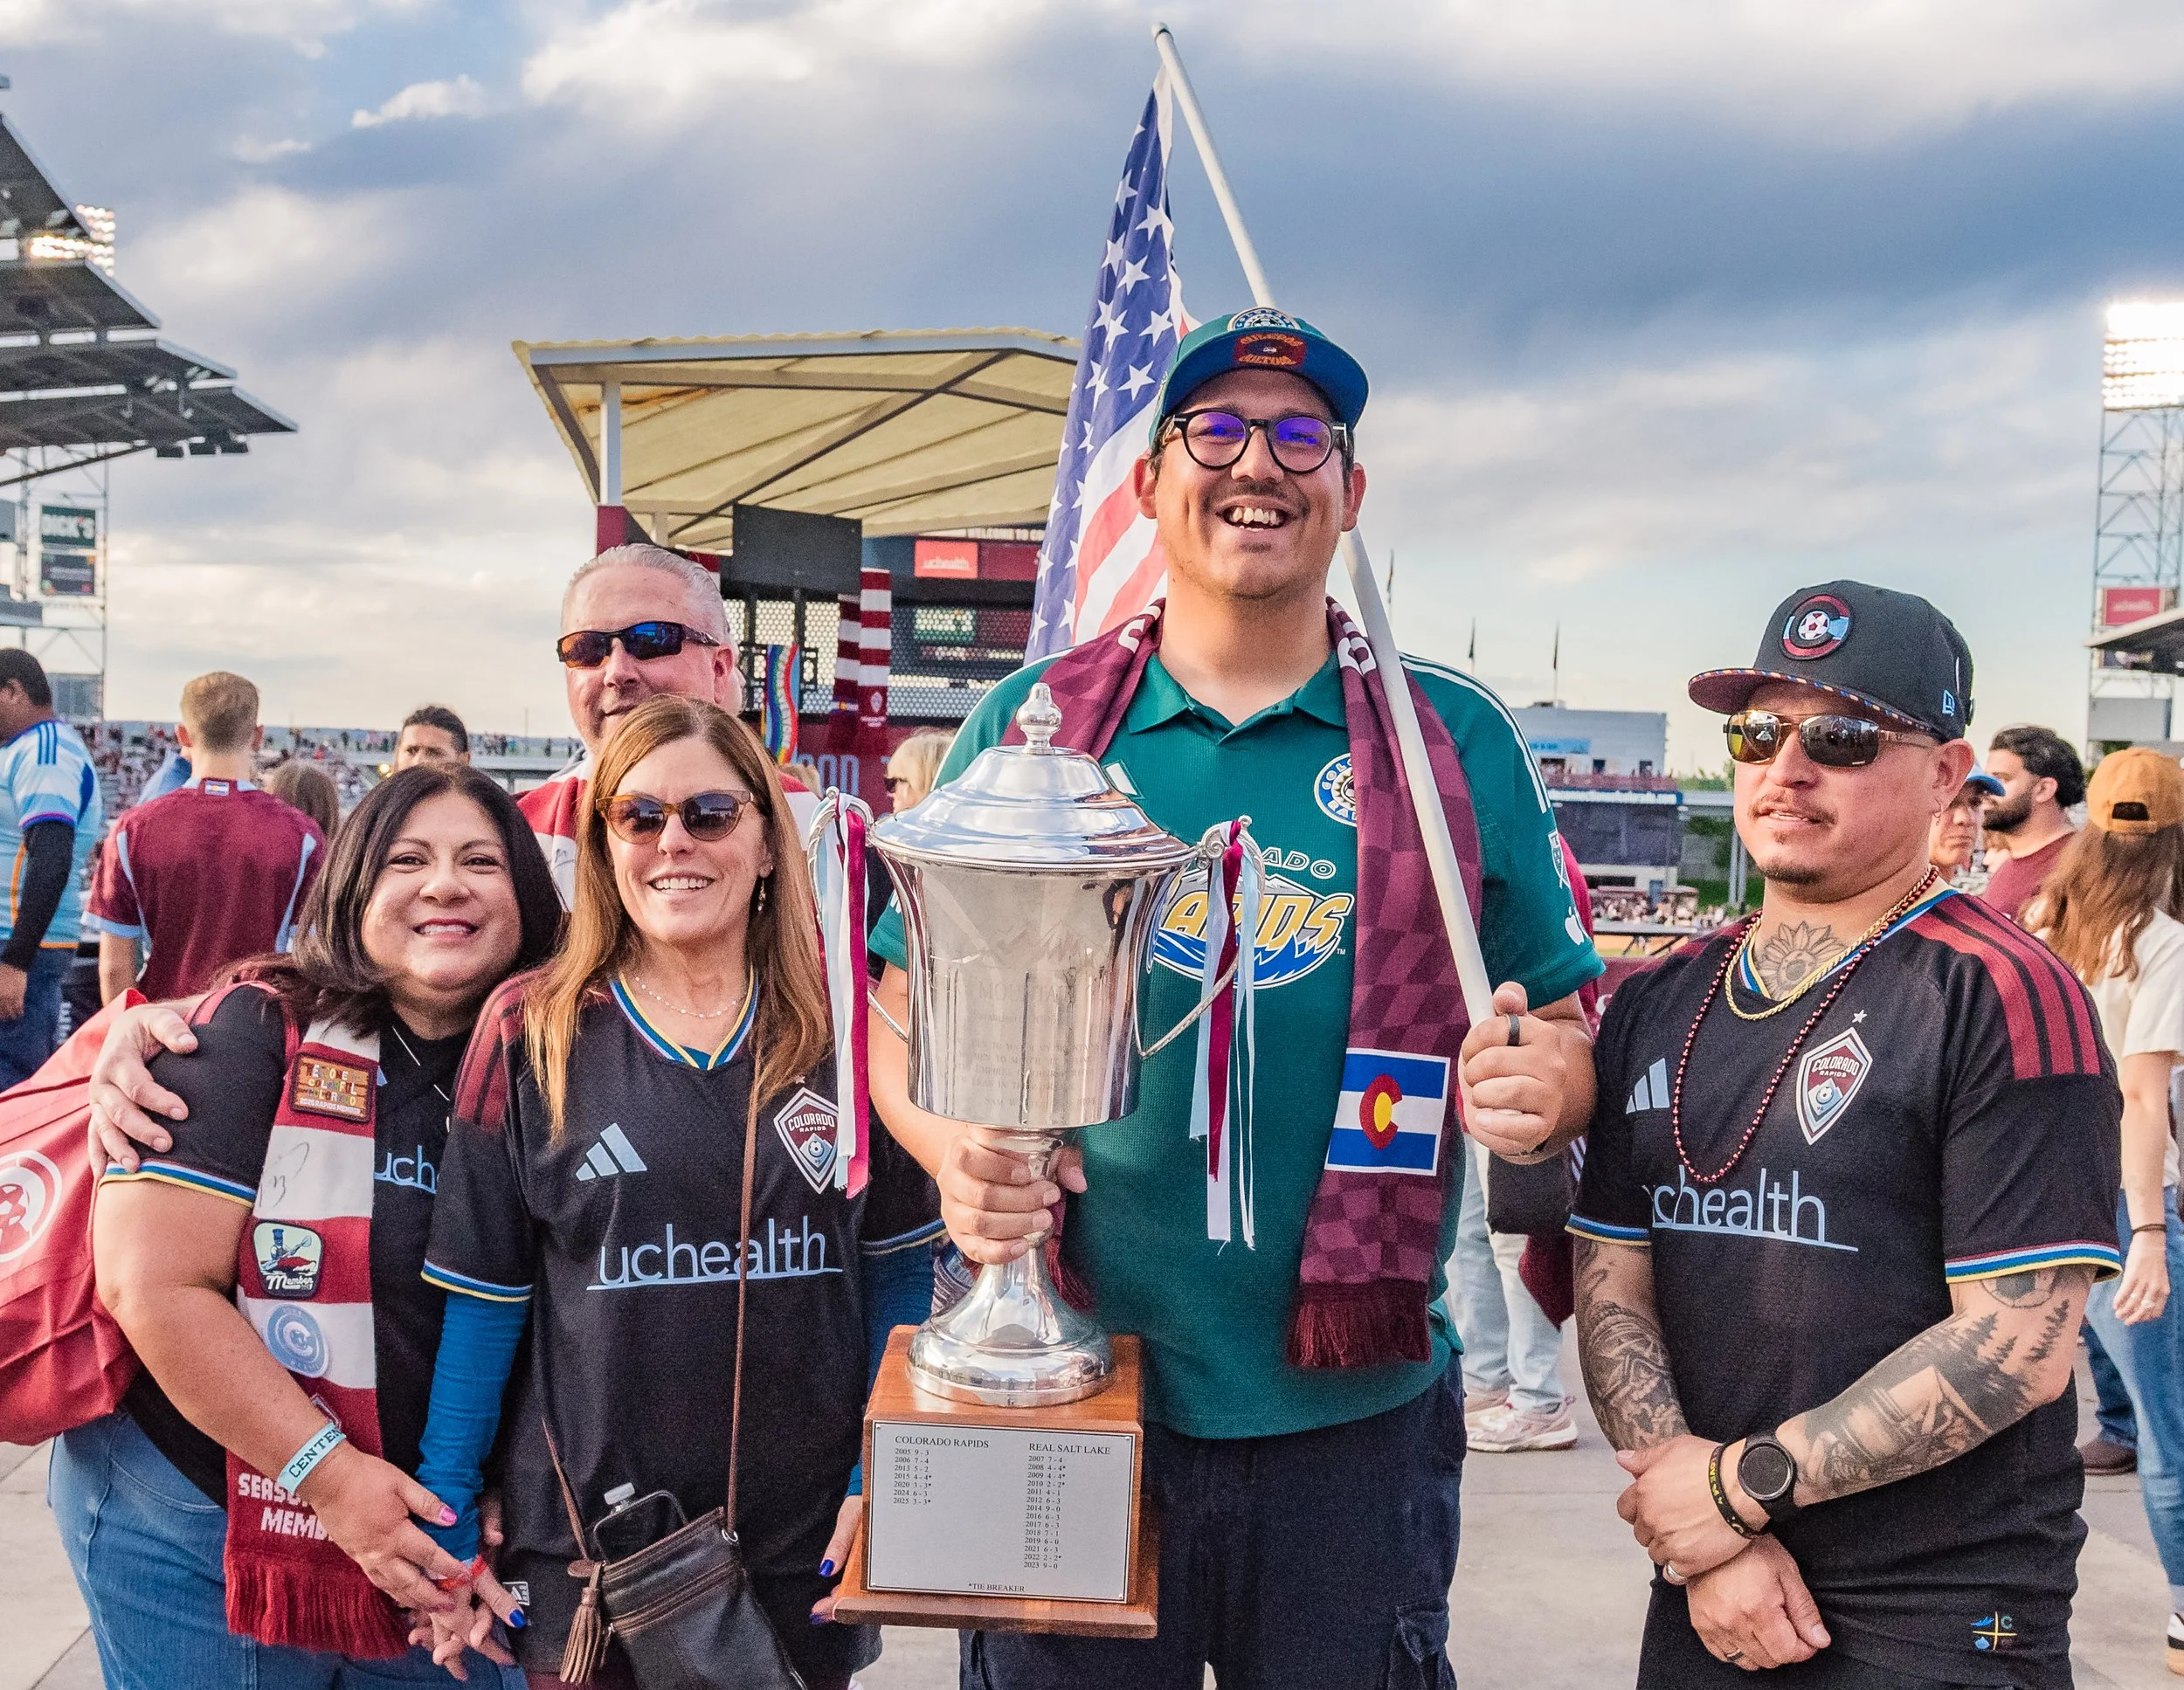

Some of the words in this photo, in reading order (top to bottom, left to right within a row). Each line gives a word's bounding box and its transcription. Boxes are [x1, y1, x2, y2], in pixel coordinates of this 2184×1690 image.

[1811, 1056, 1860, 1076] COLORADO
[788, 1113, 835, 1132] COLORADO
[599, 1215, 826, 1286] uchealth
[266, 1274, 314, 1290] Member
[895, 1436, 950, 1445] COLORADO
[954, 1439, 989, 1448] RAPIDS
[1029, 1443, 1054, 1452] REAL
[238, 1473, 308, 1507] SEAS
[260, 1507, 333, 1541] MEMB
[986, 1583, 1025, 1592] BREAKER
